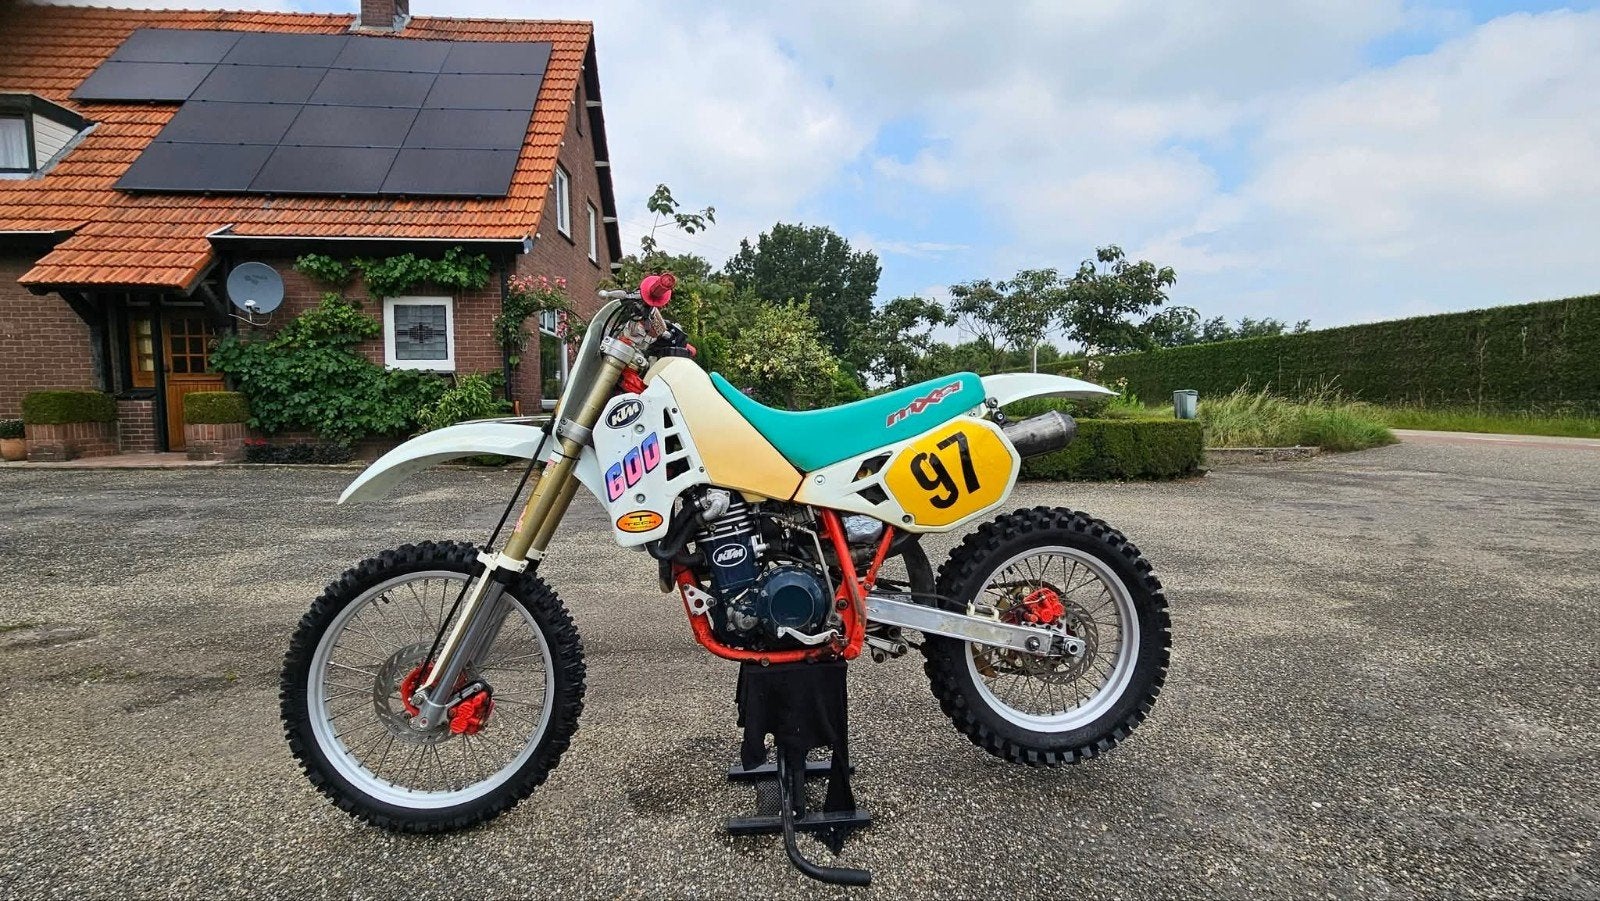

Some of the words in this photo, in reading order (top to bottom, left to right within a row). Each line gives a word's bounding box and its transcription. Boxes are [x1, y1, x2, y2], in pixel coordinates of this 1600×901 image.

[611, 402, 639, 426] KTM
[605, 431, 661, 502] 600
[910, 431, 980, 509] 97
[717, 545, 743, 562] KTM
